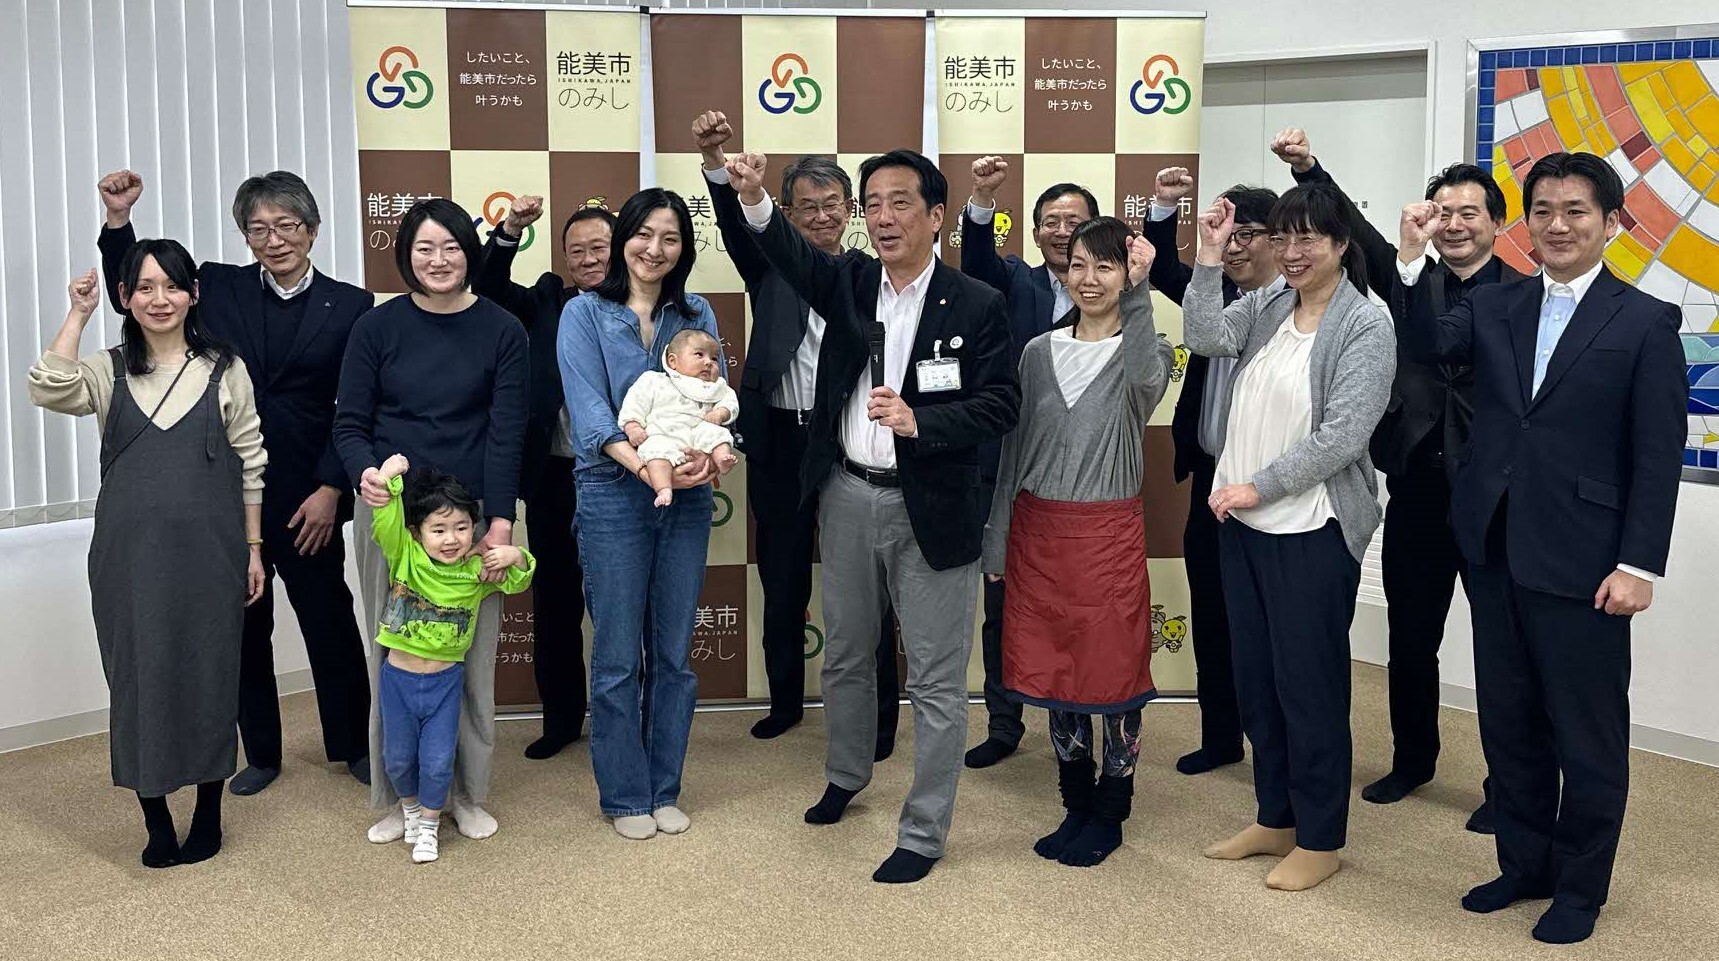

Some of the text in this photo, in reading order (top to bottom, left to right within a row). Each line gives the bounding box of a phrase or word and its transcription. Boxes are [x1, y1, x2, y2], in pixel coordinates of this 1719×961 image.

[467, 51, 530, 63] したいこと、
[556, 51, 631, 75] 能美市
[1041, 58, 1101, 69] したいこと、
[944, 56, 1016, 79] 能美市
[459, 73, 537, 84] 能美市だったら
[1034, 79, 1107, 90] 能美市だったら
[475, 95, 523, 106] 叶うかも
[558, 86, 629, 109] のみし
[945, 91, 1013, 113] のみし
[1048, 100, 1093, 111] 叶うかも
[367, 192, 443, 217] 能美
[691, 638, 736, 661] みし
